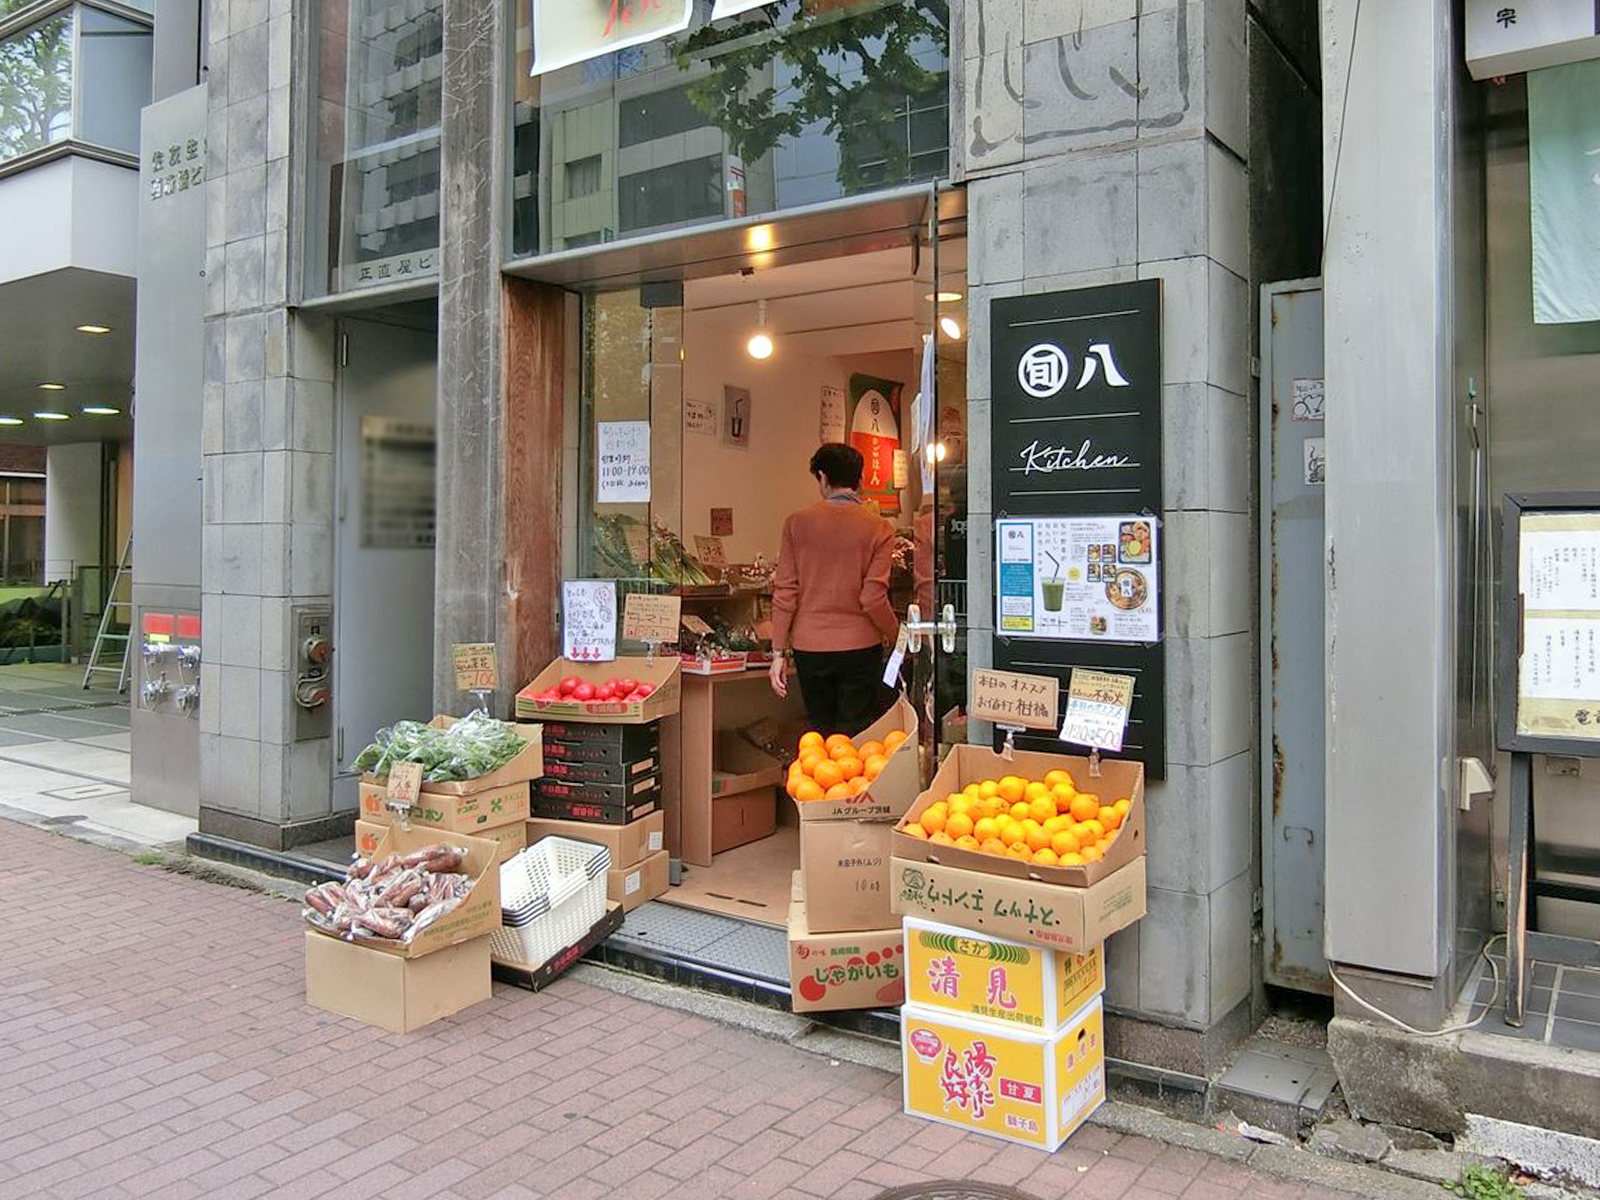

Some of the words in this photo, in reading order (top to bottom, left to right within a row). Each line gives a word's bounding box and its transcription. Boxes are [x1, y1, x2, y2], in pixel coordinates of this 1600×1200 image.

[1496, 8, 1517, 29] 宗
[152, 138, 207, 173] 住友生
[1019, 439, 1130, 475] Kitchen
[978, 675, 1007, 689] 本日の
[927, 884, 984, 912] エンドウ
[959, 939, 988, 956] さが
[815, 963, 900, 983] じゃがいも
[928, 955, 1018, 1010] 清見
[940, 1046, 971, 1109] 良好
[1007, 1081, 1035, 1099] 甘夏
